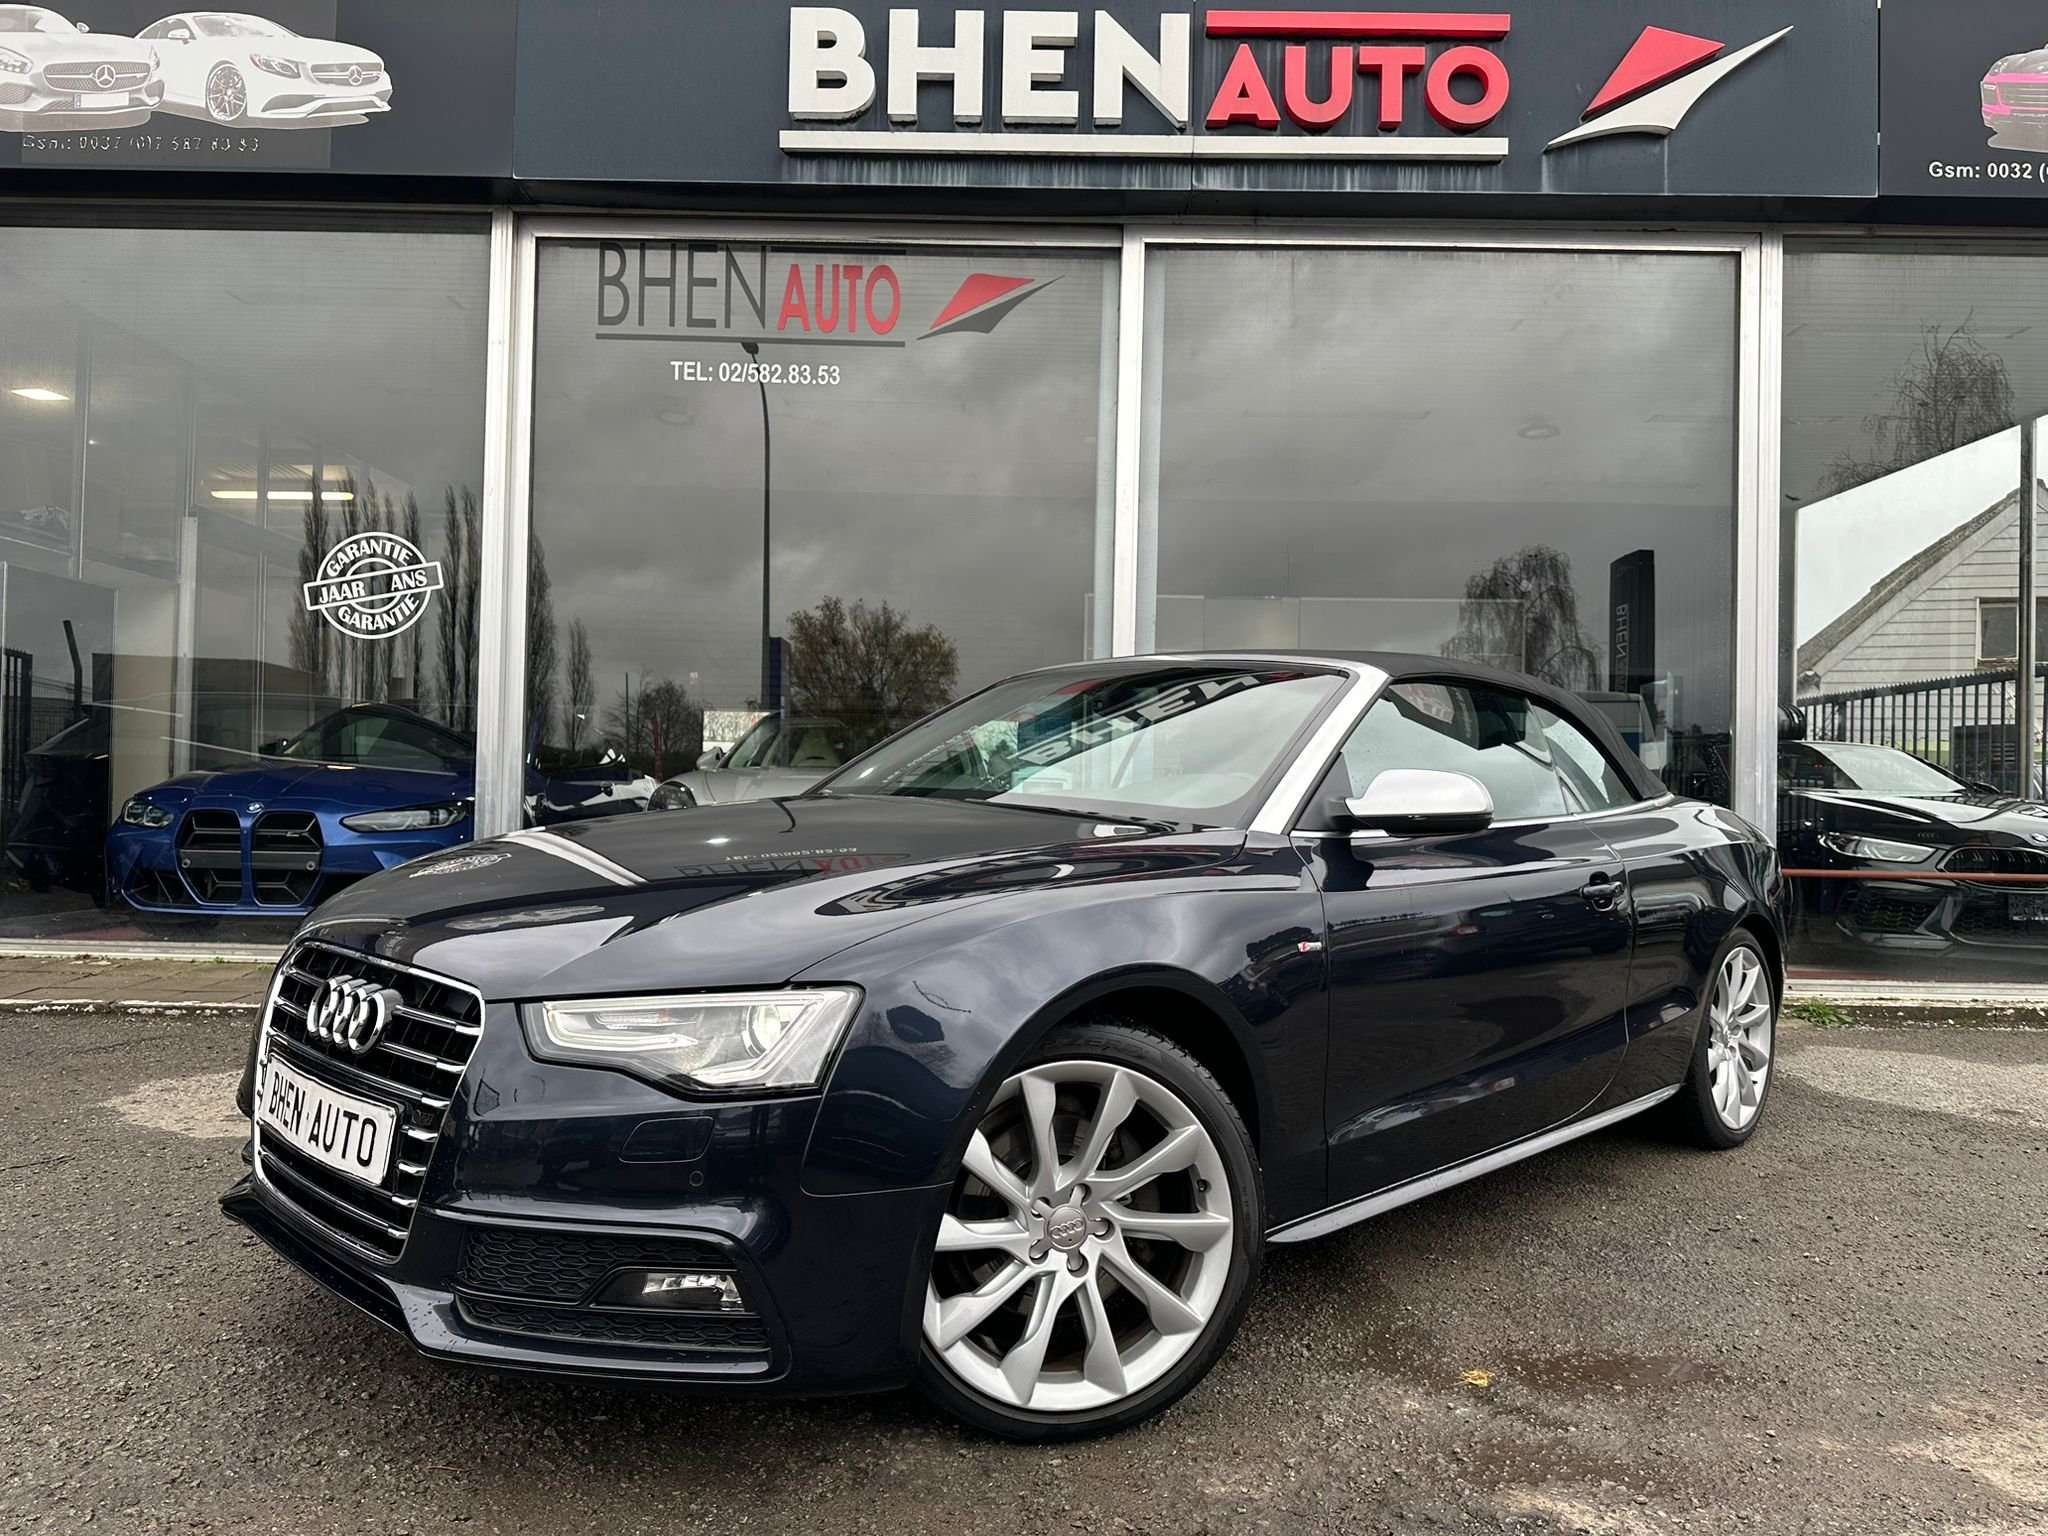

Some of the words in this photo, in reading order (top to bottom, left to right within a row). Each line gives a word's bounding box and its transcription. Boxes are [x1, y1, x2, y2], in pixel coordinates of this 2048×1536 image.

[789, 7, 1190, 129] BHEN
[1205, 43, 1510, 131] AUTO
[1928, 161, 1981, 179] Gsm:
[1987, 162, 2033, 179] 0032
[597, 243, 767, 329] BHEN
[777, 263, 901, 335] AUTO
[670, 361, 713, 382] TEL:
[718, 362, 841, 385] 02/582.83.53
[326, 539, 413, 577] GARANTIE
[319, 580, 366, 604] JAAR
[391, 569, 428, 592] ANS
[338, 593, 419, 631] GARANTIE
[269, 1071, 306, 1136] BHEN
[308, 1099, 377, 1167] AUTO
